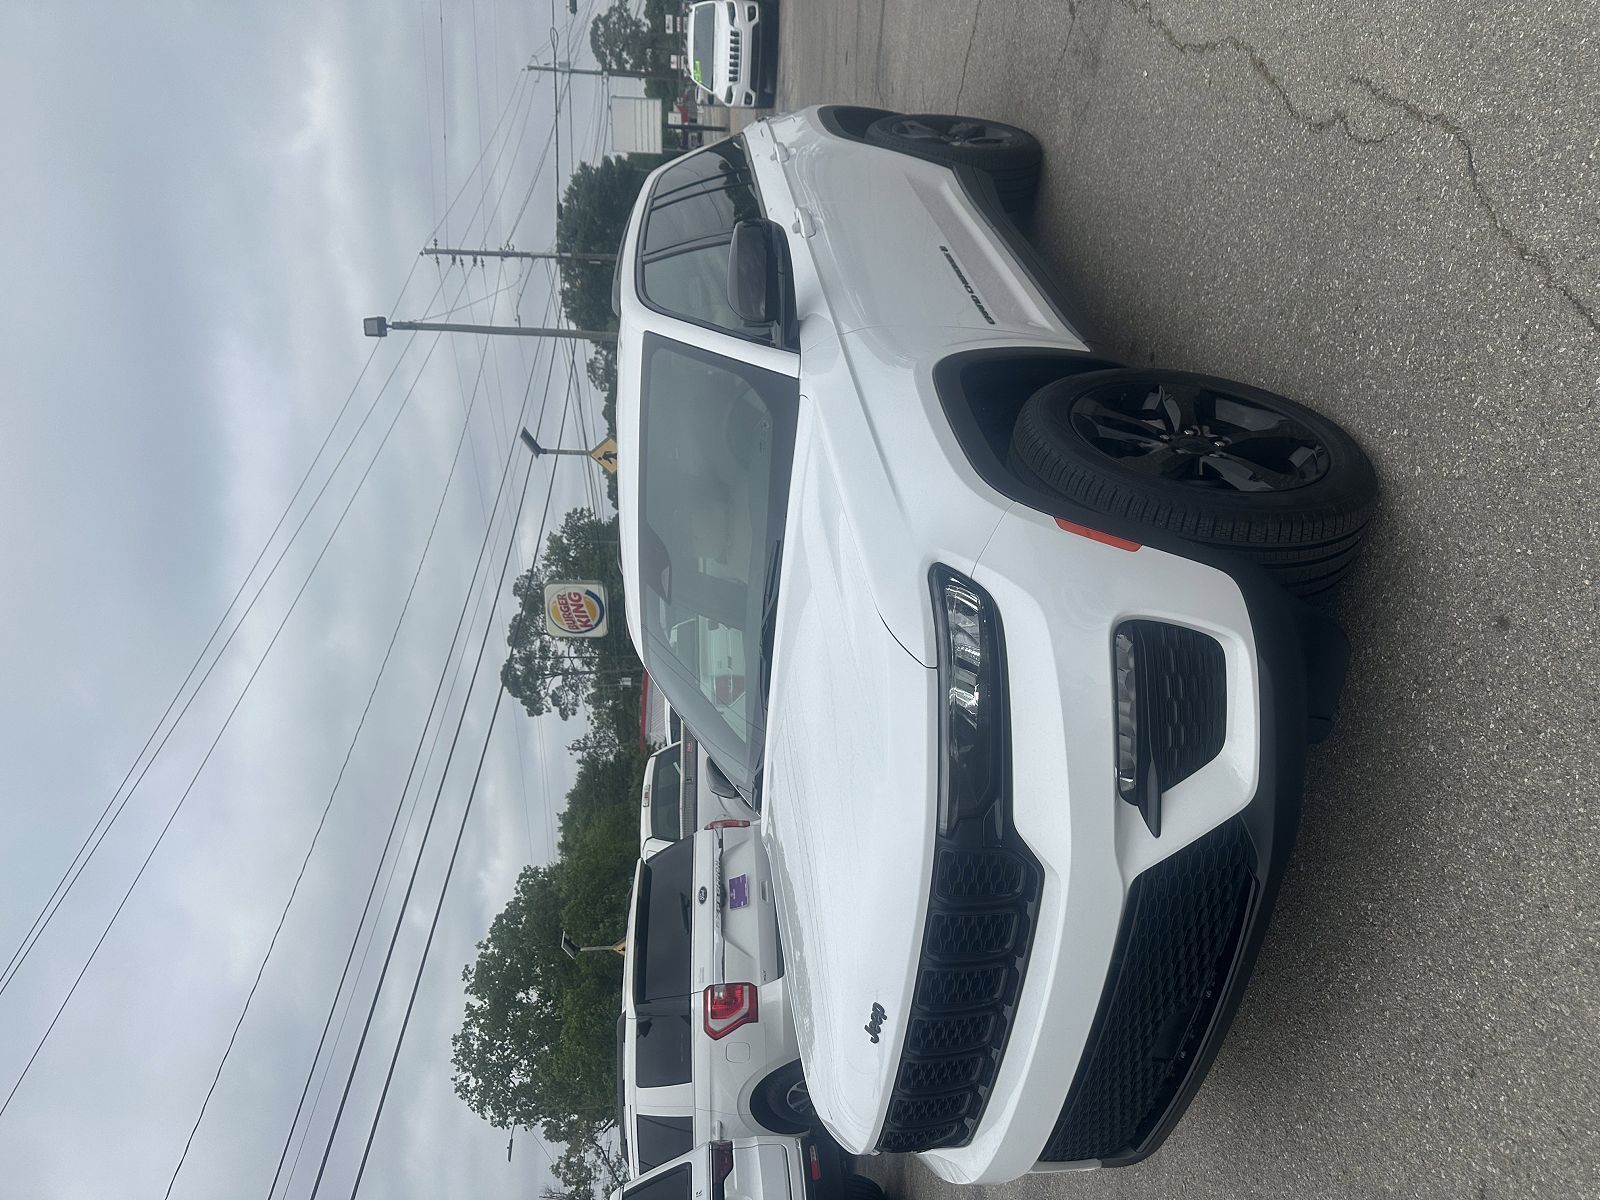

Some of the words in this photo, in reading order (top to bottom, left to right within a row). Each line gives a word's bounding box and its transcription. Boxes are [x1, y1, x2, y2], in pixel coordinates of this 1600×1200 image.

[557, 594, 580, 630] BURGER
[568, 592, 593, 628] KING
[864, 1001, 888, 1044] Jeep
